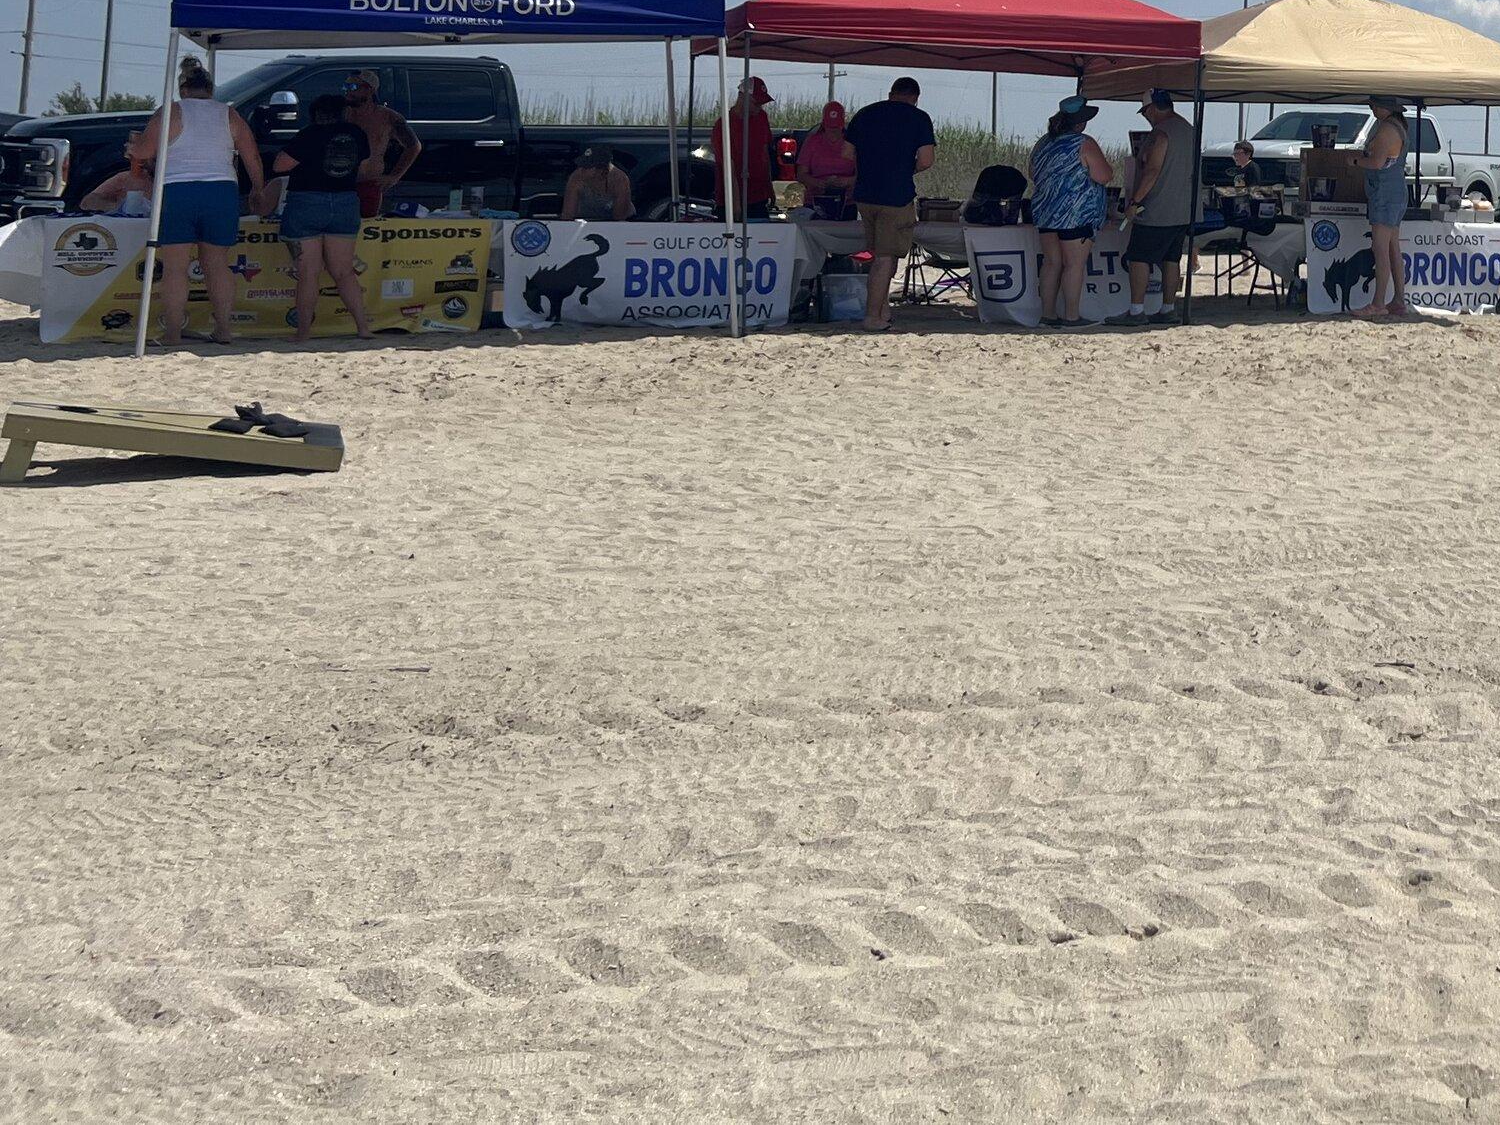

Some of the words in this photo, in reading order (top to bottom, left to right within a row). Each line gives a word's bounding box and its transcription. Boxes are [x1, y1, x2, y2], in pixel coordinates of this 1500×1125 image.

[424, 16, 447, 25] LAKE
[491, 18, 504, 26] LA
[363, 226, 482, 242] Sponsors
[1414, 234, 1442, 246] GULF
[1445, 235, 1485, 246] COAST
[653, 237, 695, 250] GULF
[624, 256, 777, 298] BRONCO
[1404, 291, 1500, 307] SSOCIATION
[621, 303, 774, 322] ASSOCIATION
